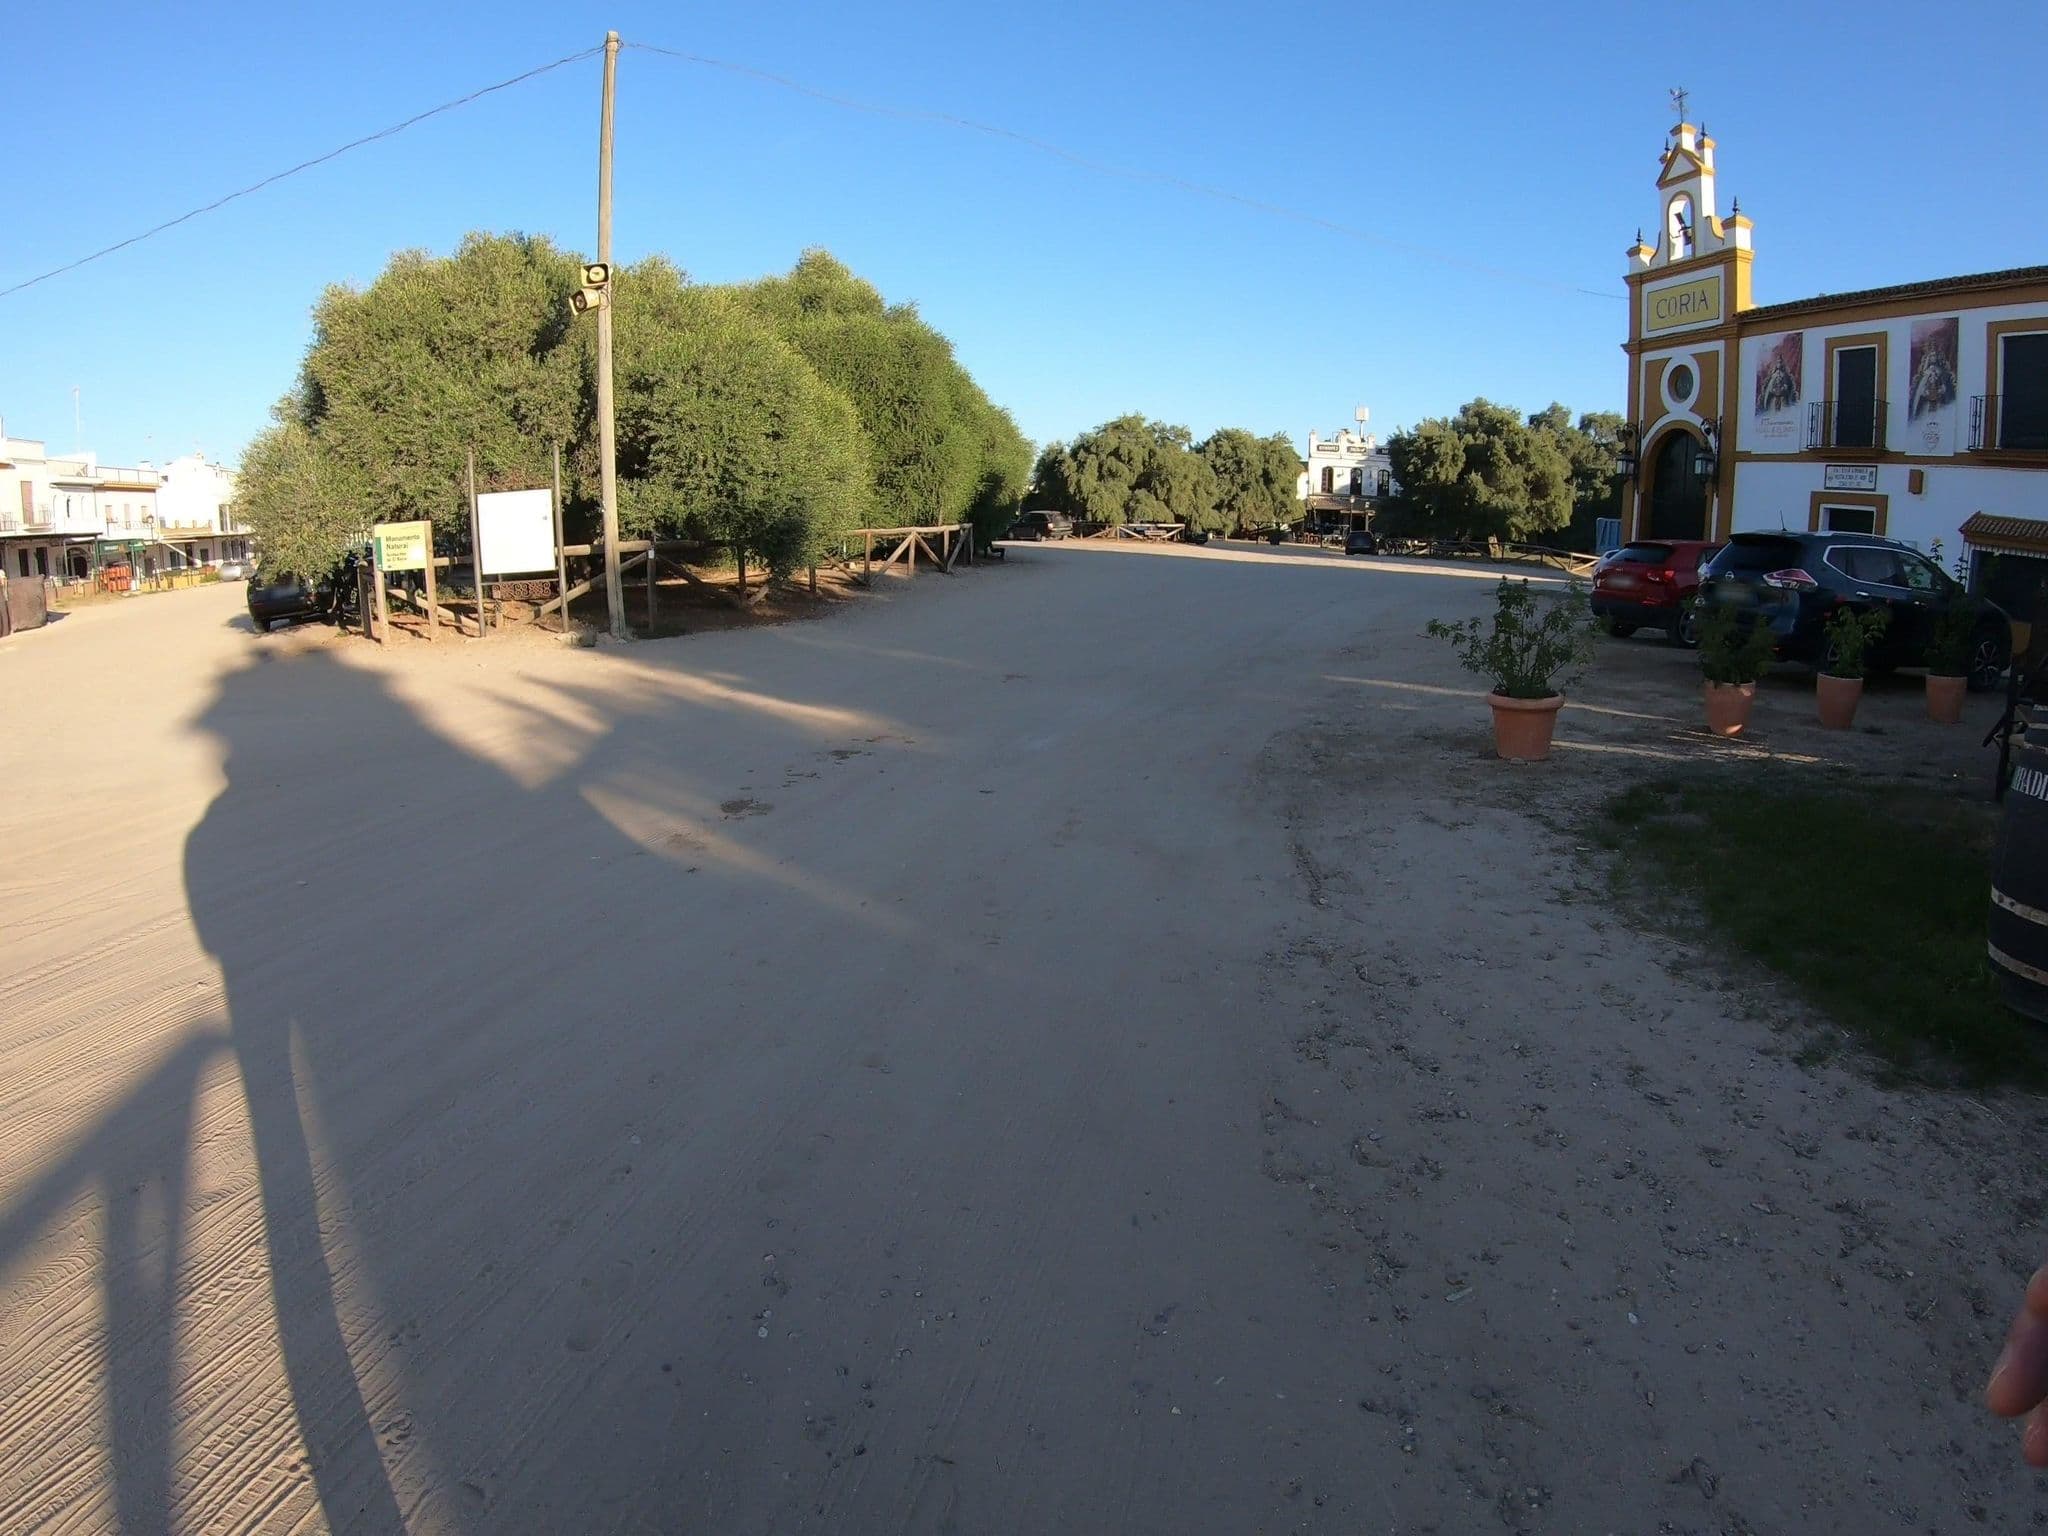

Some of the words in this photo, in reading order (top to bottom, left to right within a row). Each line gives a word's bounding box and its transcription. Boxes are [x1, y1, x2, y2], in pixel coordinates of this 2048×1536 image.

[1656, 289, 1708, 319] CORIA
[385, 534, 421, 542] Monumento
[386, 542, 409, 550] Natural
